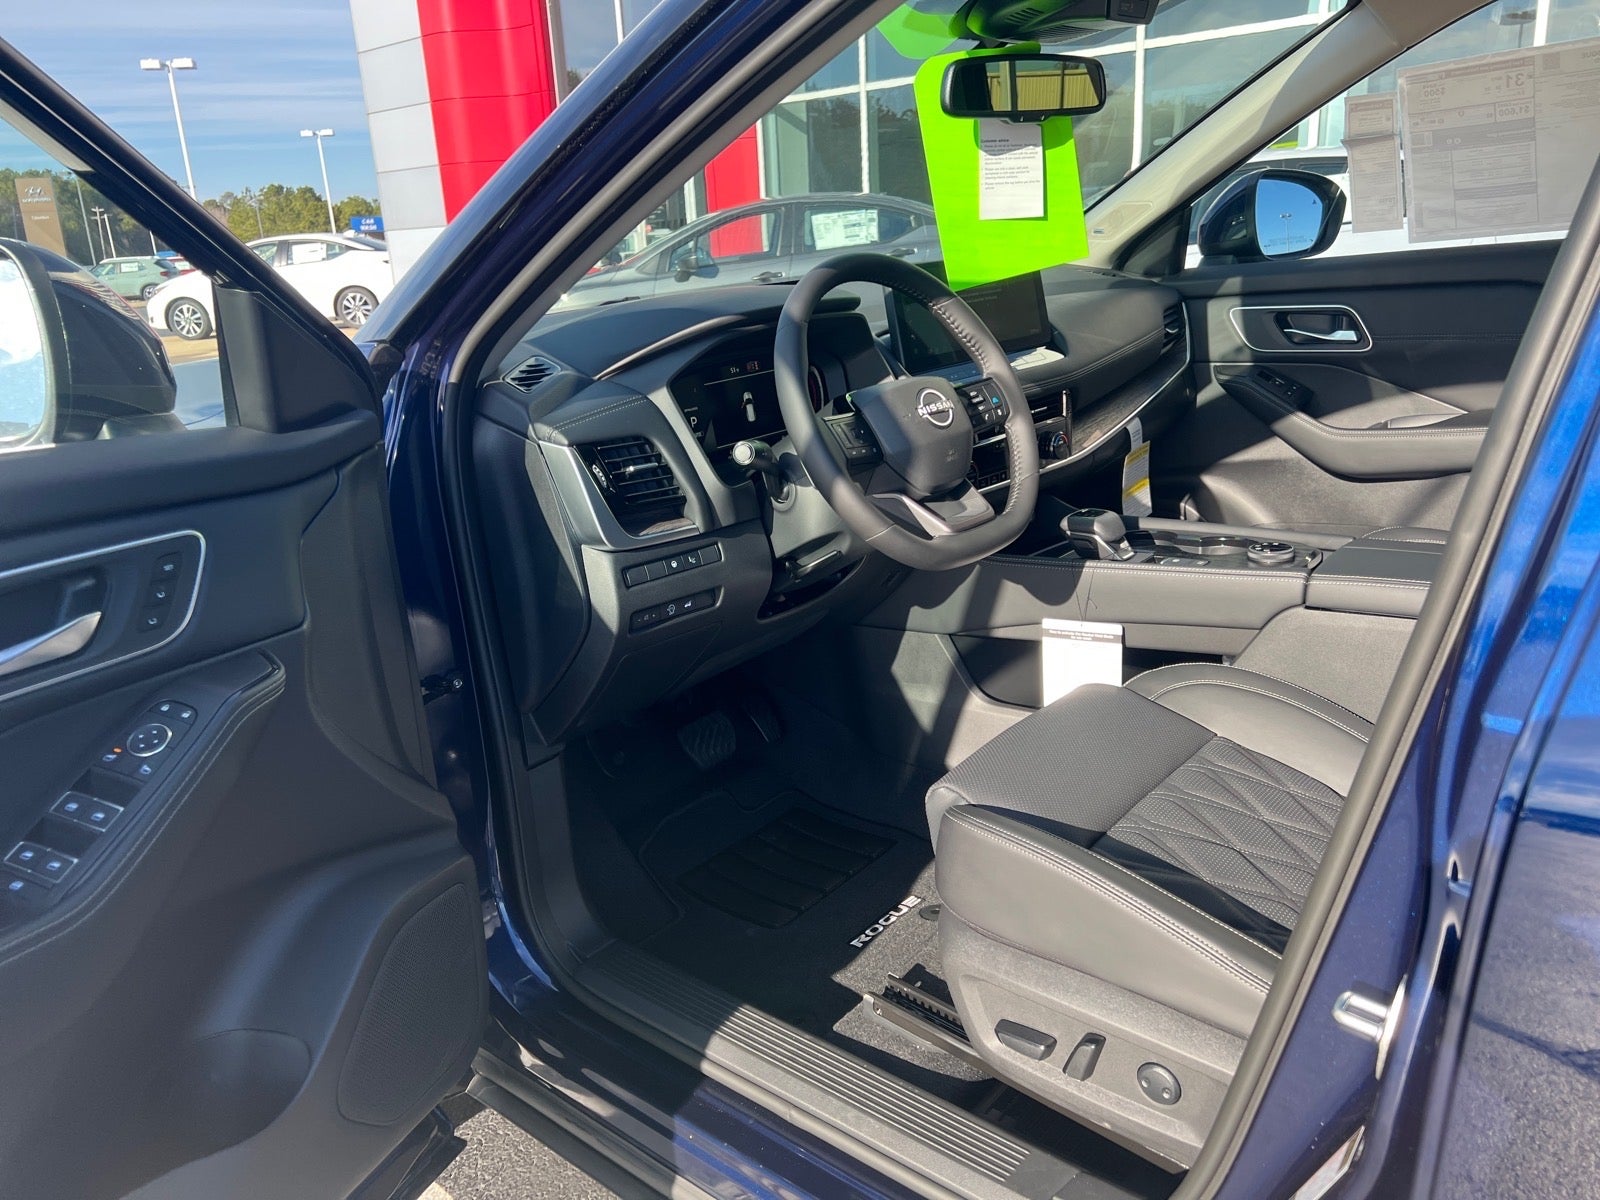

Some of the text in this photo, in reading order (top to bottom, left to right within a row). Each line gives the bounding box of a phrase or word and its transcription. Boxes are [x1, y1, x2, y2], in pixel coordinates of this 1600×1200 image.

[917, 399, 955, 418] NISSAN
[690, 416, 698, 428] P
[850, 895, 921, 948] ROGUE
